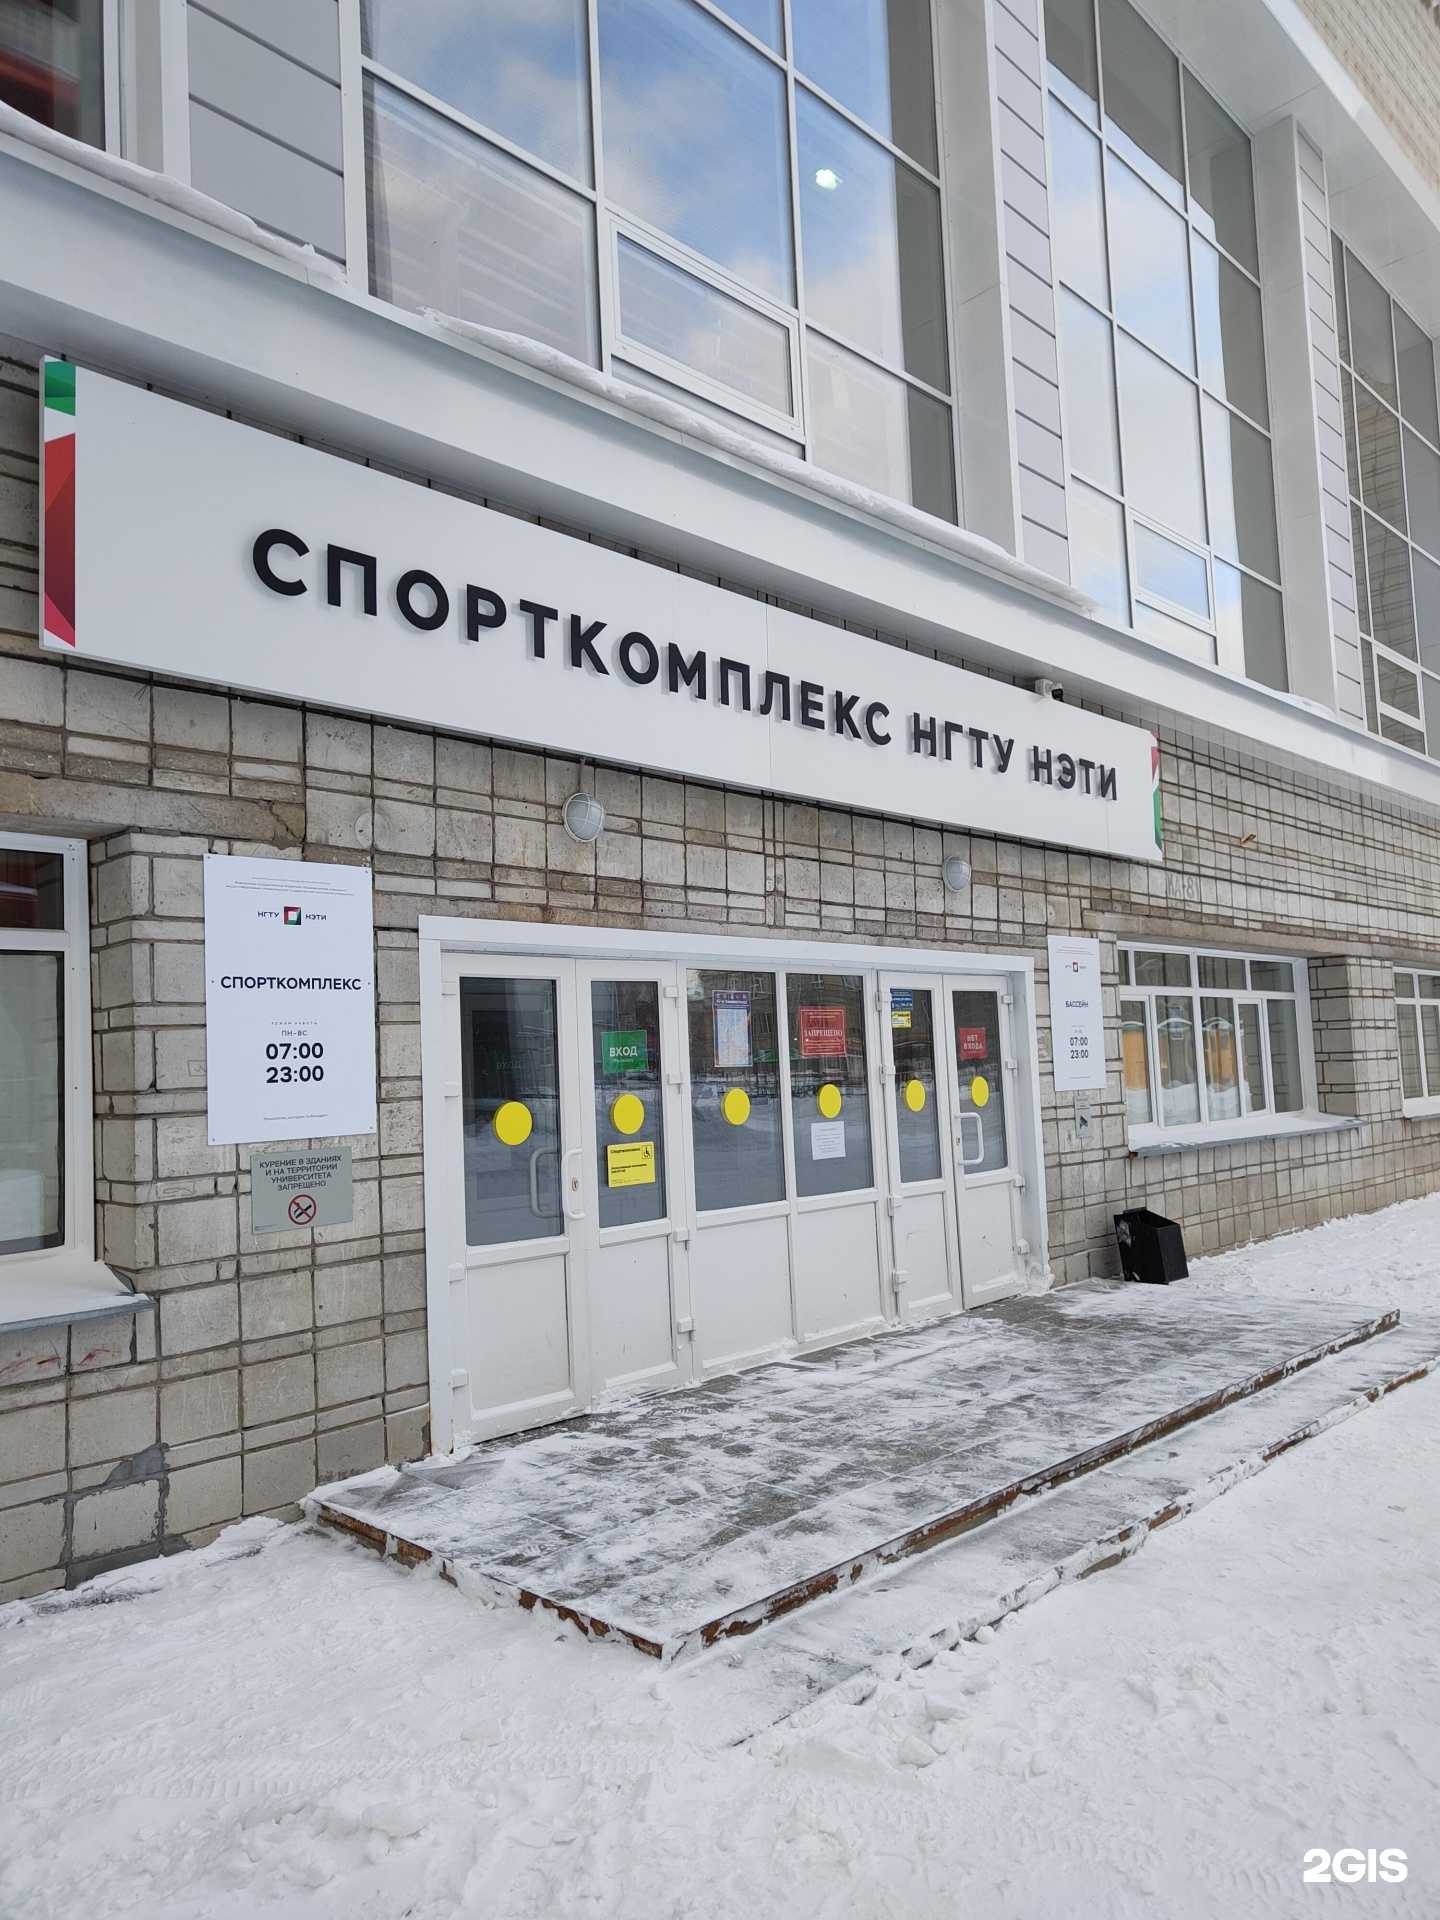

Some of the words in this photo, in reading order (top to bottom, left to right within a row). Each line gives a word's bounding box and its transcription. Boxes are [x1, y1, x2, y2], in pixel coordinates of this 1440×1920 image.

[252, 528, 891, 746] СПОРТКОМПЛЕКС
[912, 711, 1015, 774] НГТУ
[1032, 745, 1118, 801] НЭТИ
[257, 911, 280, 919] НГТУ
[305, 913, 327, 921] НЭТИ
[220, 976, 362, 990] СПОРТКОМПЛЕКС
[1065, 1000, 1089, 1008] БАССЕЙН
[1069, 1036, 1089, 1047] 07:00
[265, 1042, 324, 1060] 07:00
[609, 1045, 638, 1057] ВХОД
[1070, 1049, 1089, 1059] 23:00
[265, 1065, 324, 1084] 23:00
[259, 1159, 297, 1169] КУРЕНИЕ
[298, 1158, 305, 1166] В
[305, 1155, 342, 1165] ЗДАНИЯХ
[273, 1168, 285, 1176] НА
[287, 1163, 338, 1174] ТЕРРИТОРИИ
[271, 1172, 332, 1184] УНИВЕРСИТЕТА
[277, 1181, 326, 1192] ЗАПРЕЩЕНО
